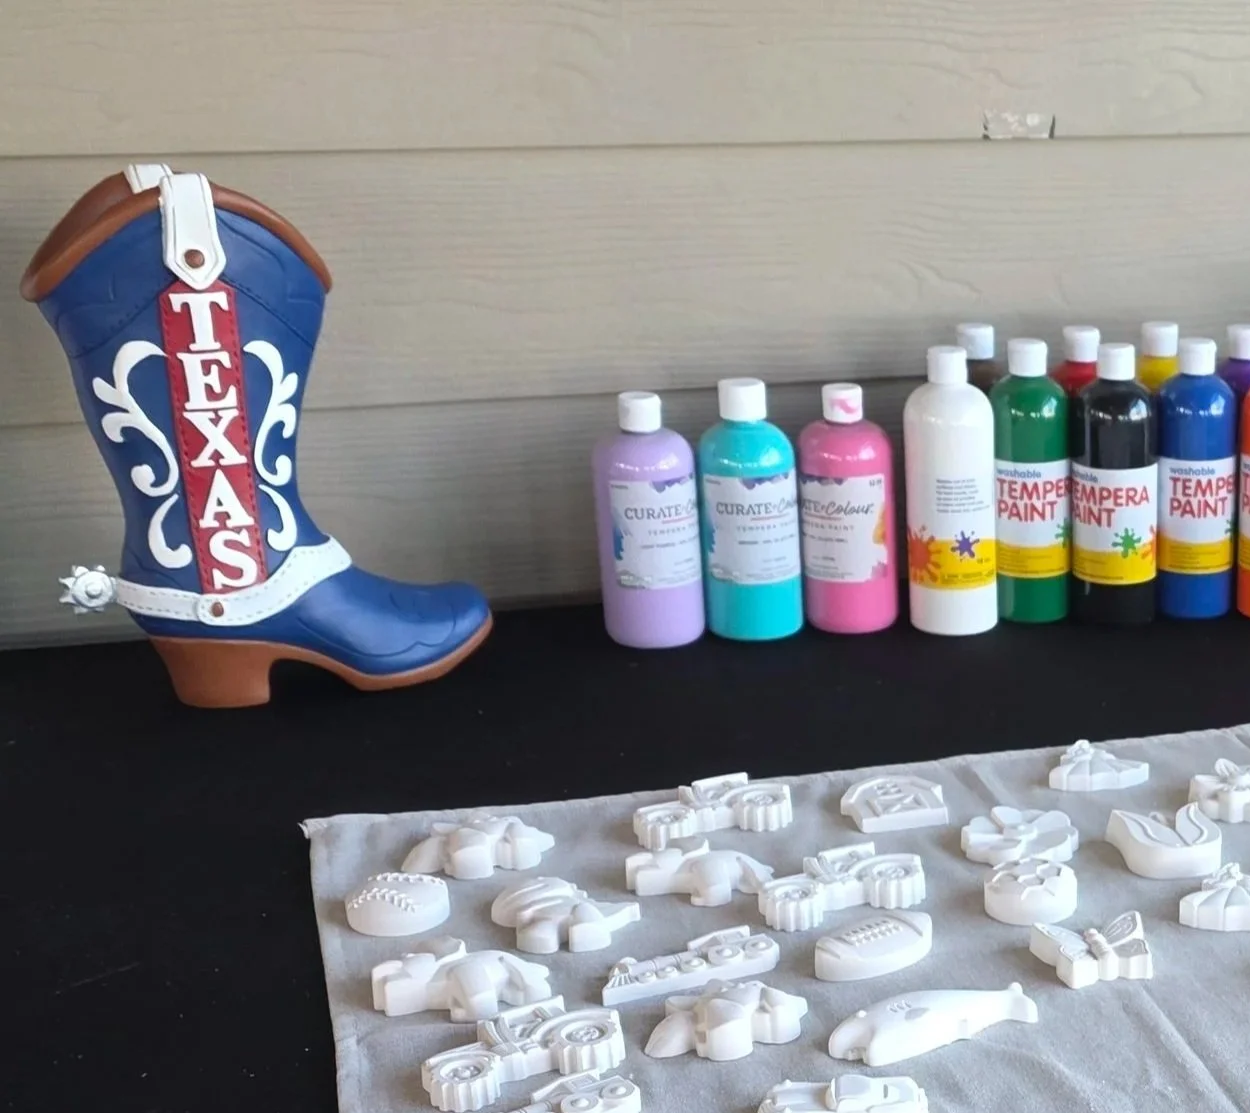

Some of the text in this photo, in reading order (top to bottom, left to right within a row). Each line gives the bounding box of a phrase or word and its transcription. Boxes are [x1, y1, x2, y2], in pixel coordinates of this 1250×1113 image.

[169, 291, 258, 590] TEXAS
[1169, 466, 1216, 476] washable
[624, 503, 682, 521] CURATE
[716, 501, 773, 516] CURATE
[997, 500, 1058, 522] PAINT
[1169, 497, 1228, 518] PAINT
